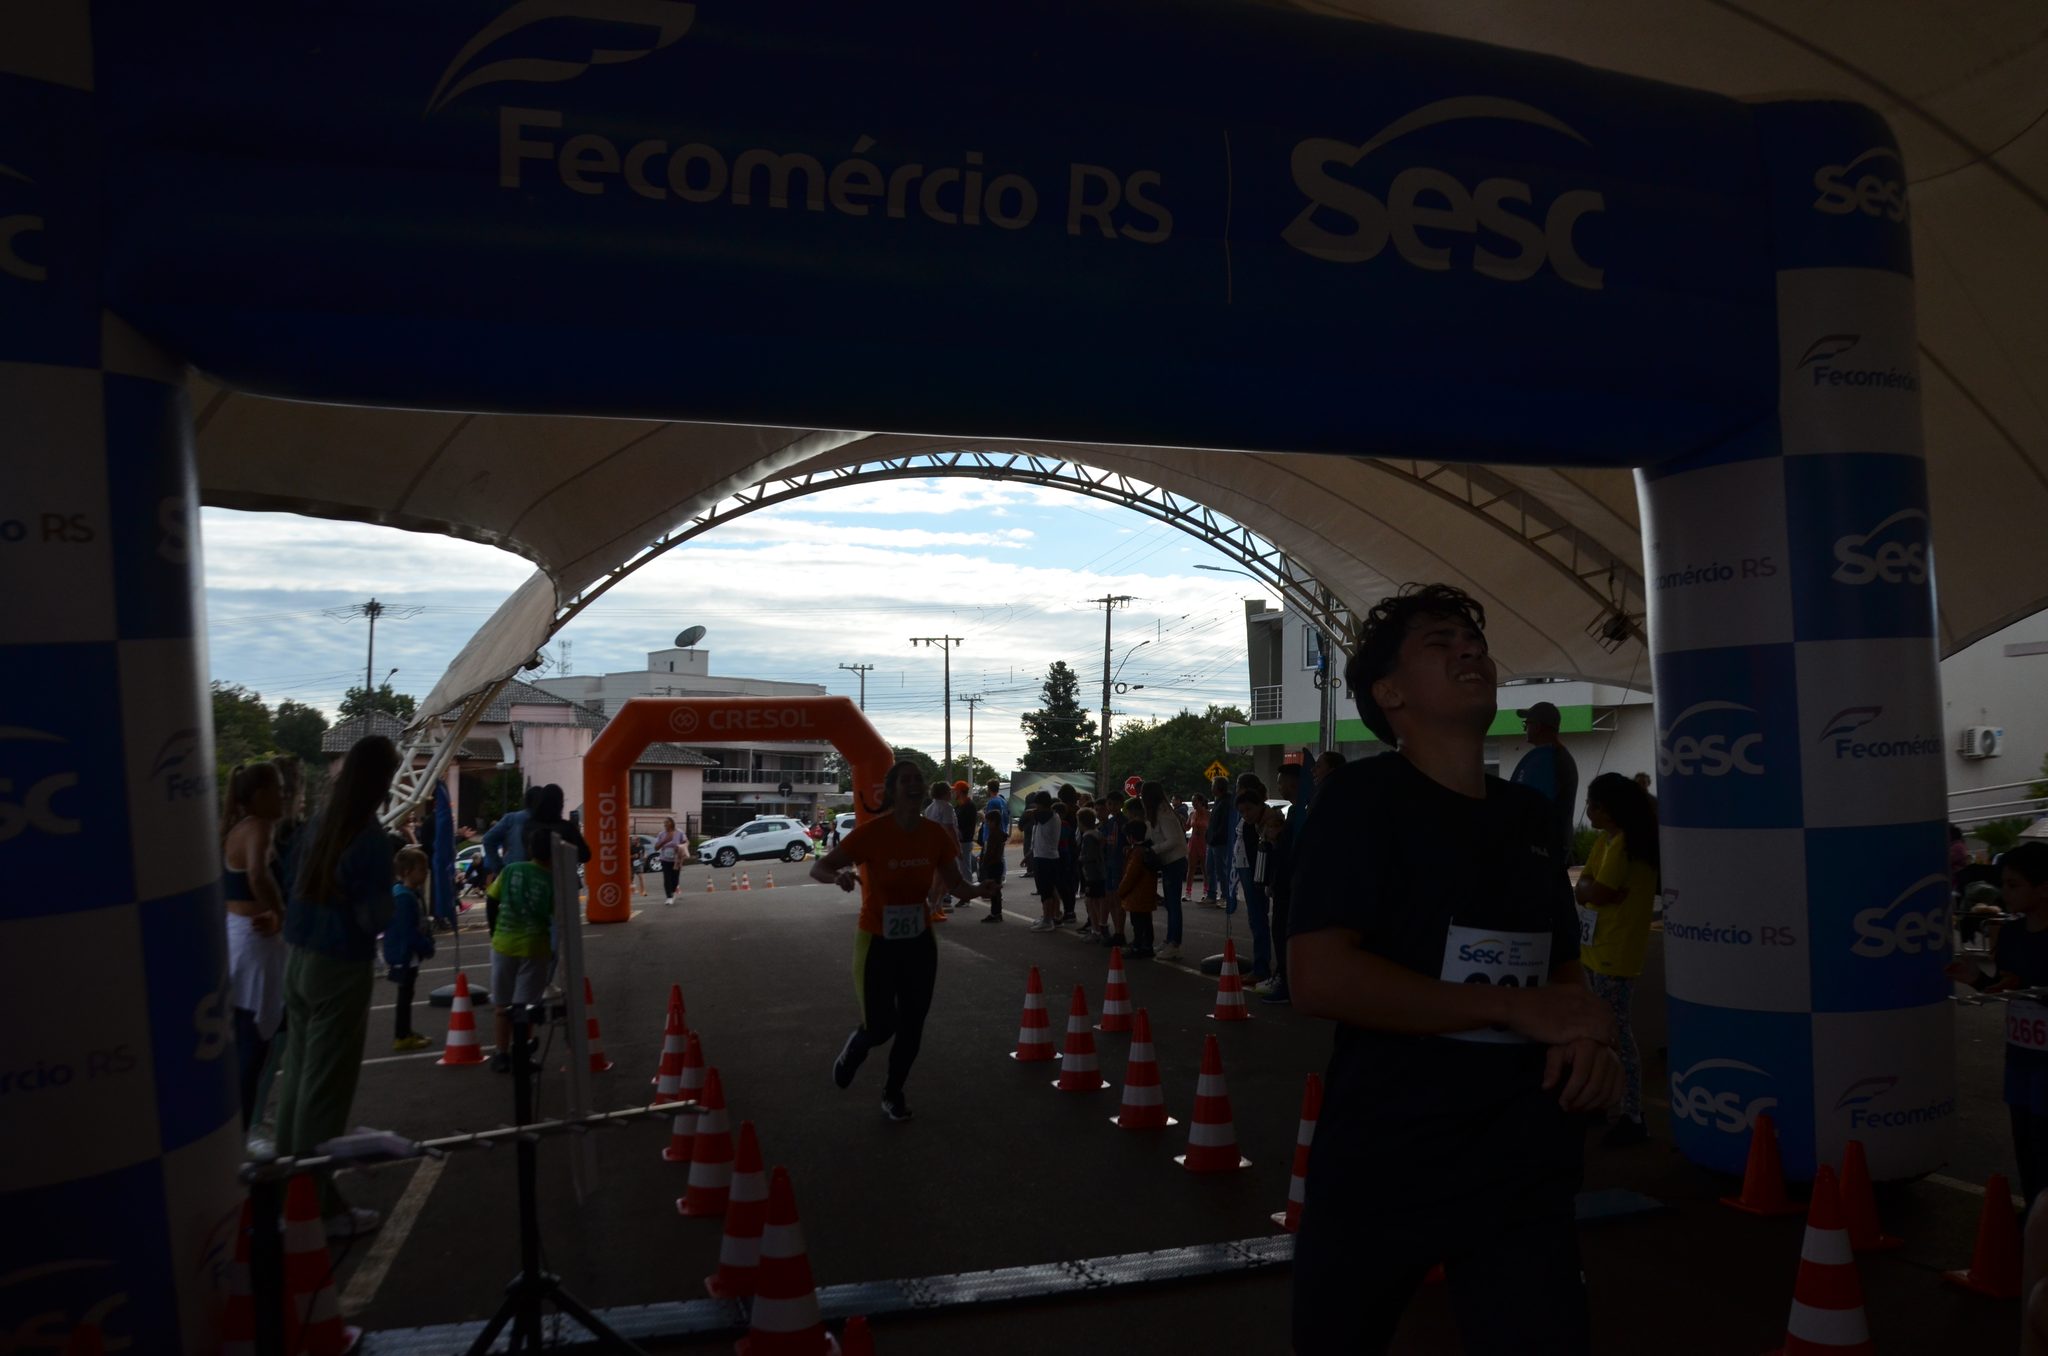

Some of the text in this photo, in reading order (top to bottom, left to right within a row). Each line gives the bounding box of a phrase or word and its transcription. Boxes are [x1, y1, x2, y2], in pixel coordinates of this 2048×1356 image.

[499, 105, 1175, 244] Fecomércio RS
[1811, 164, 1908, 223] Ses
[1280, 136, 1606, 290] Sesc
[41, 513, 95, 543] RS
[1741, 556, 1777, 579] RS
[1831, 533, 1927, 586] Ses
[707, 707, 815, 730] CRESOL
[598, 785, 618, 876] CRESOL
[888, 915, 919, 936] 261
[1664, 916, 1797, 946] ecomércio RS
[1458, 943, 1505, 965] Sesc
